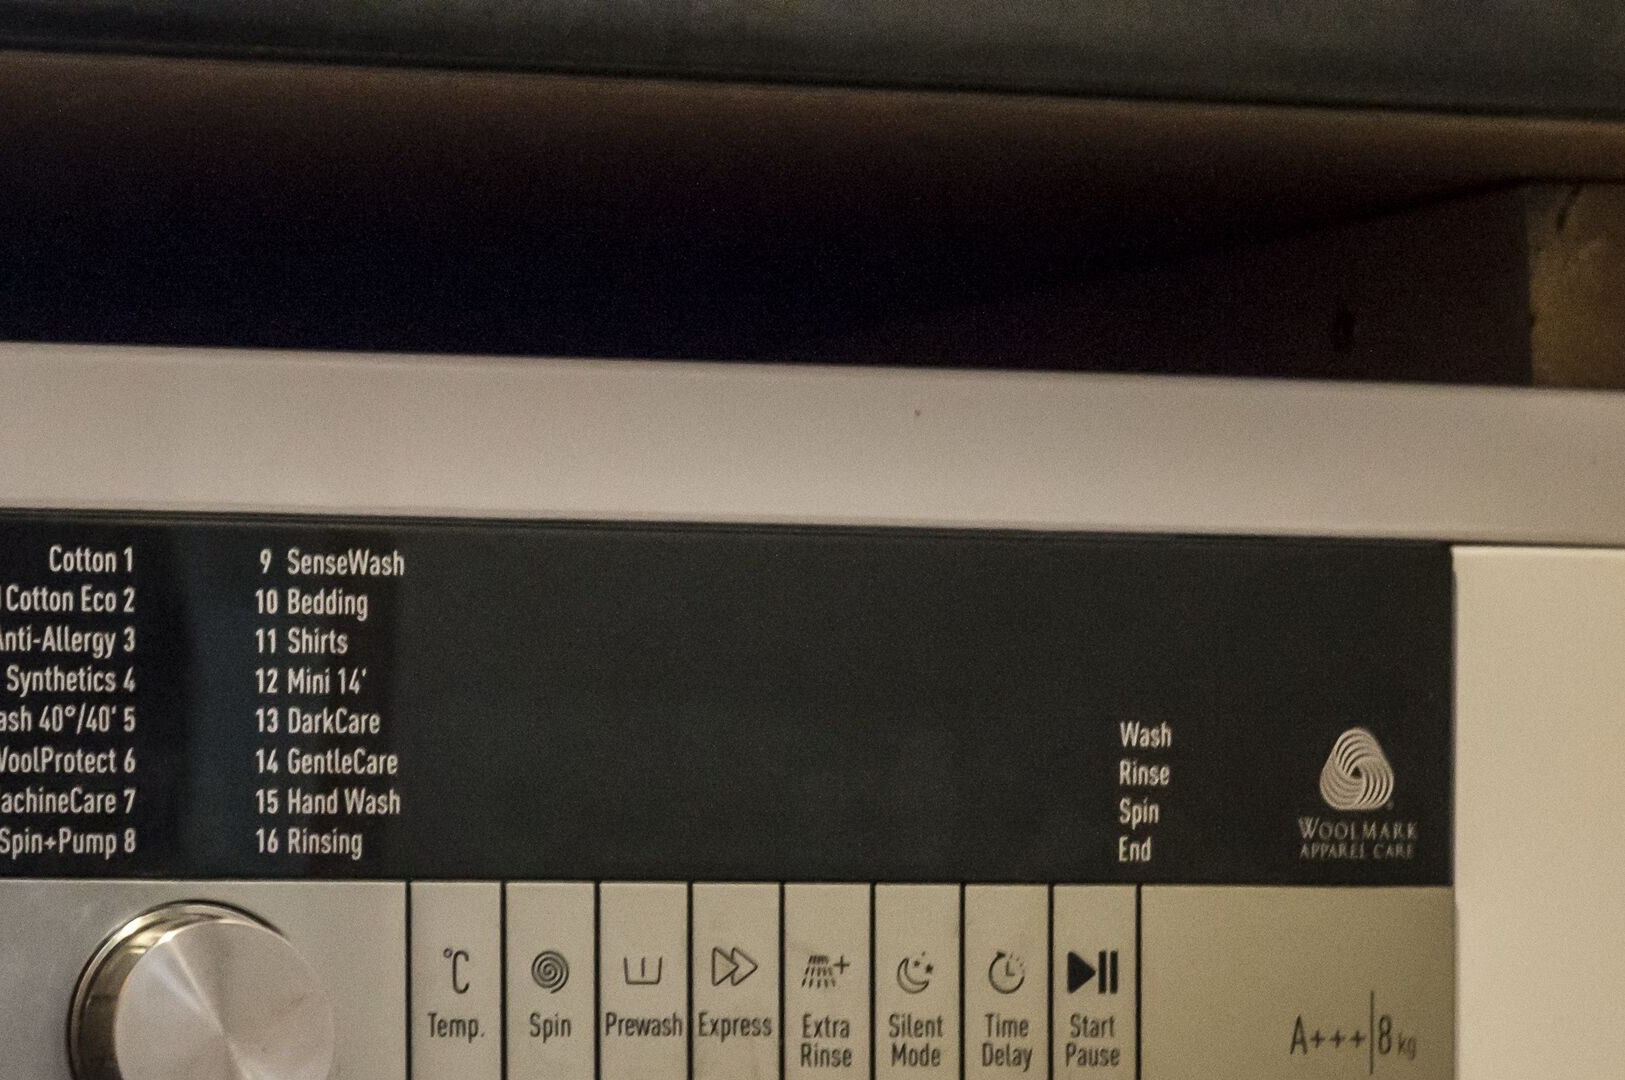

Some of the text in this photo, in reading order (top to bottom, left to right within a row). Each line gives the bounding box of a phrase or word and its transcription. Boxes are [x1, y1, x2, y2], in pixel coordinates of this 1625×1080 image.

[49, 545, 134, 573] Cotton 1
[259, 549, 405, 576] 9 SenseWash
[5, 586, 135, 612] Cotton Eco 2
[255, 589, 368, 622] 10 Bedding
[123, 627, 135, 652] 3
[255, 628, 348, 654] 11 Shirts
[6, 666, 136, 697] Synthetics 4
[255, 669, 278, 693] 12
[287, 669, 330, 694] Mini
[124, 707, 135, 732] 5
[255, 708, 380, 735] 13 DarkCare
[1119, 721, 1172, 748] Wash
[124, 748, 135, 772] 6
[255, 749, 398, 776] 14 GentleCare
[1119, 760, 1170, 786] Rinse
[124, 789, 135, 813] 7
[255, 789, 401, 815] 15 Hand Wash
[1119, 798, 1159, 829] Spin
[124, 829, 136, 853] 8
[255, 829, 363, 860] 16 Rinsing
[1118, 836, 1151, 862] End
[428, 1011, 485, 1043] Temp.
[530, 1012, 571, 1043] Spin
[605, 1012, 682, 1036] Prewash
[698, 1012, 772, 1042] Express
[802, 1013, 850, 1039] Extra
[888, 1013, 943, 1038] Silent
[985, 1013, 1029, 1038] Time
[1070, 1013, 1115, 1038] Start
[1378, 1015, 1393, 1055] 8
[1397, 1035, 1417, 1061] kg
[801, 1043, 852, 1067] Rinse
[891, 1043, 941, 1067] Mode
[982, 1042, 1033, 1072] Delay
[1066, 1042, 1120, 1067] Pause
